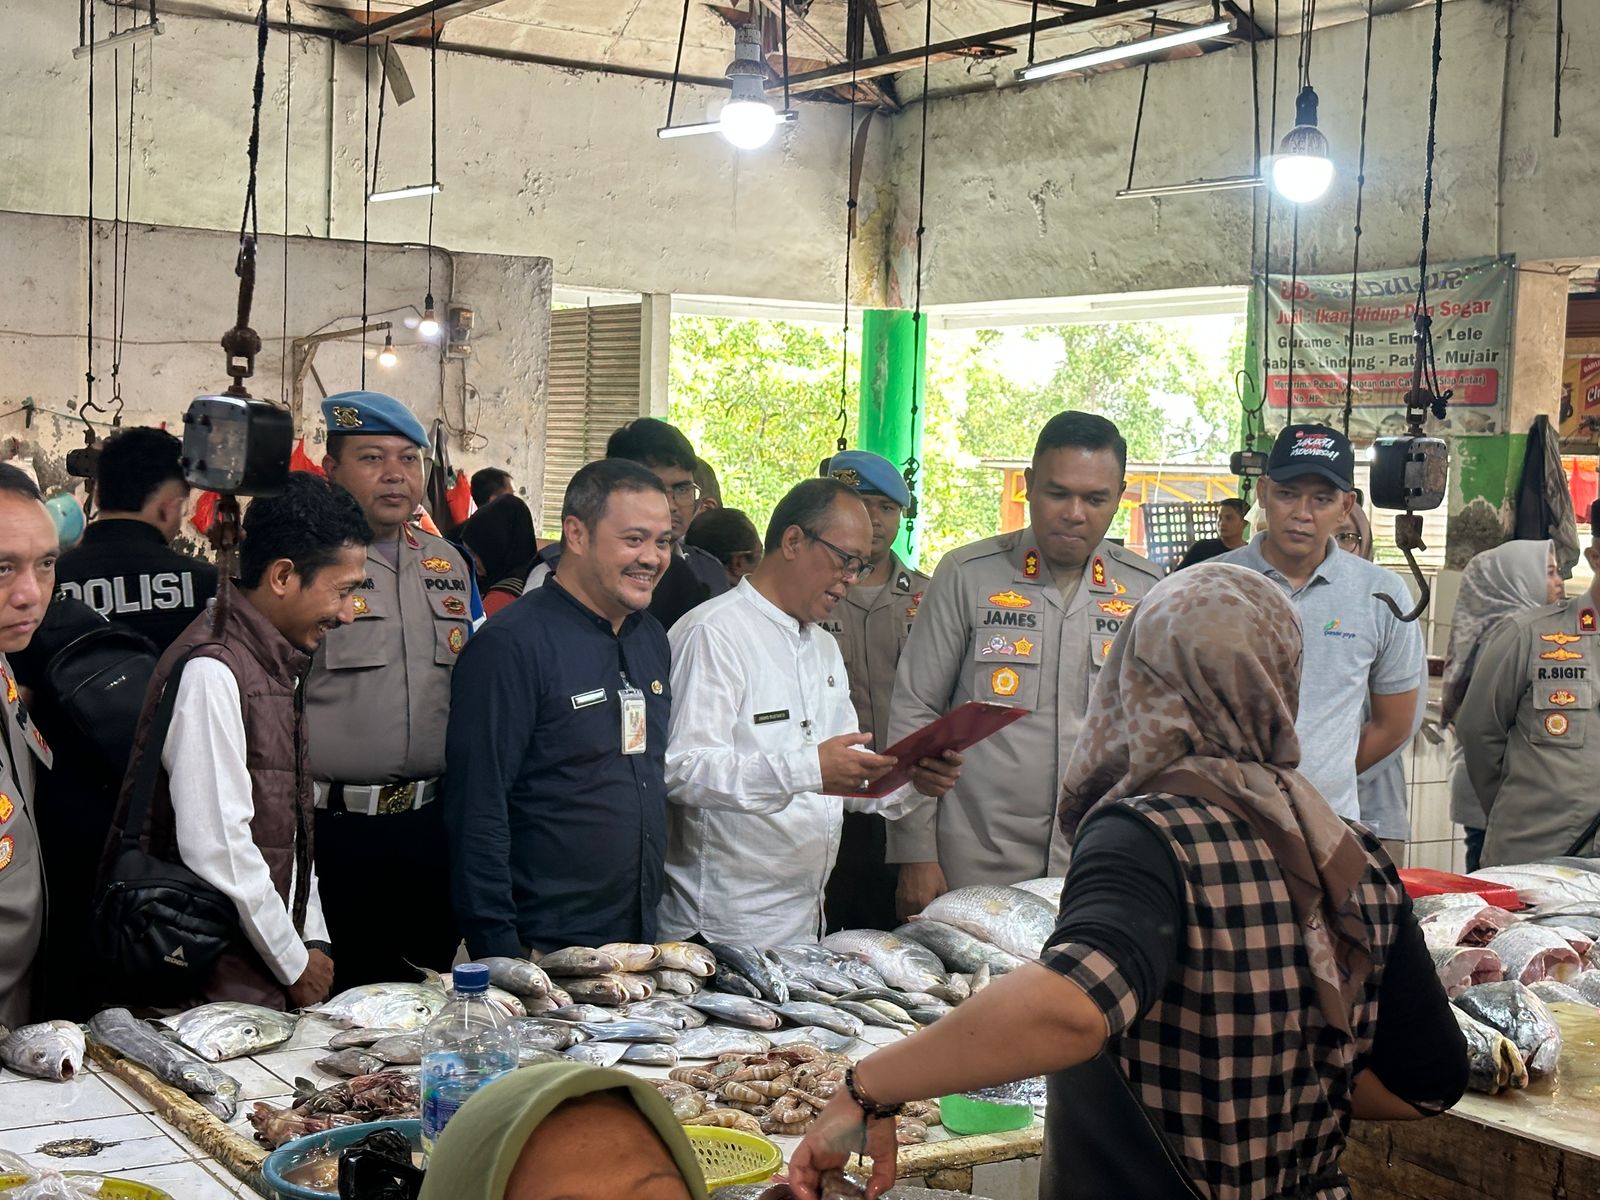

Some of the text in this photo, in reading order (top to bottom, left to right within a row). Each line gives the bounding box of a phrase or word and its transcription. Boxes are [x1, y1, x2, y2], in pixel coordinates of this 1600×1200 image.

[1316, 308, 1348, 323] Ikan
[1354, 306, 1400, 323] Hidup
[1440, 300, 1490, 318] Segar
[1278, 336, 1331, 348] Gurame
[1344, 333, 1374, 347] Nila
[1447, 328, 1482, 341] Lele
[1262, 358, 1305, 369] Gabus
[1318, 354, 1375, 370] Lindung
[1446, 349, 1499, 365] Mujair
[60, 571, 194, 616] POLISI
[424, 578, 466, 591] POLRI
[983, 610, 1036, 628] JAMES
[1096, 617, 1122, 634] PO
[1538, 667, 1587, 680] R.SIGIT
